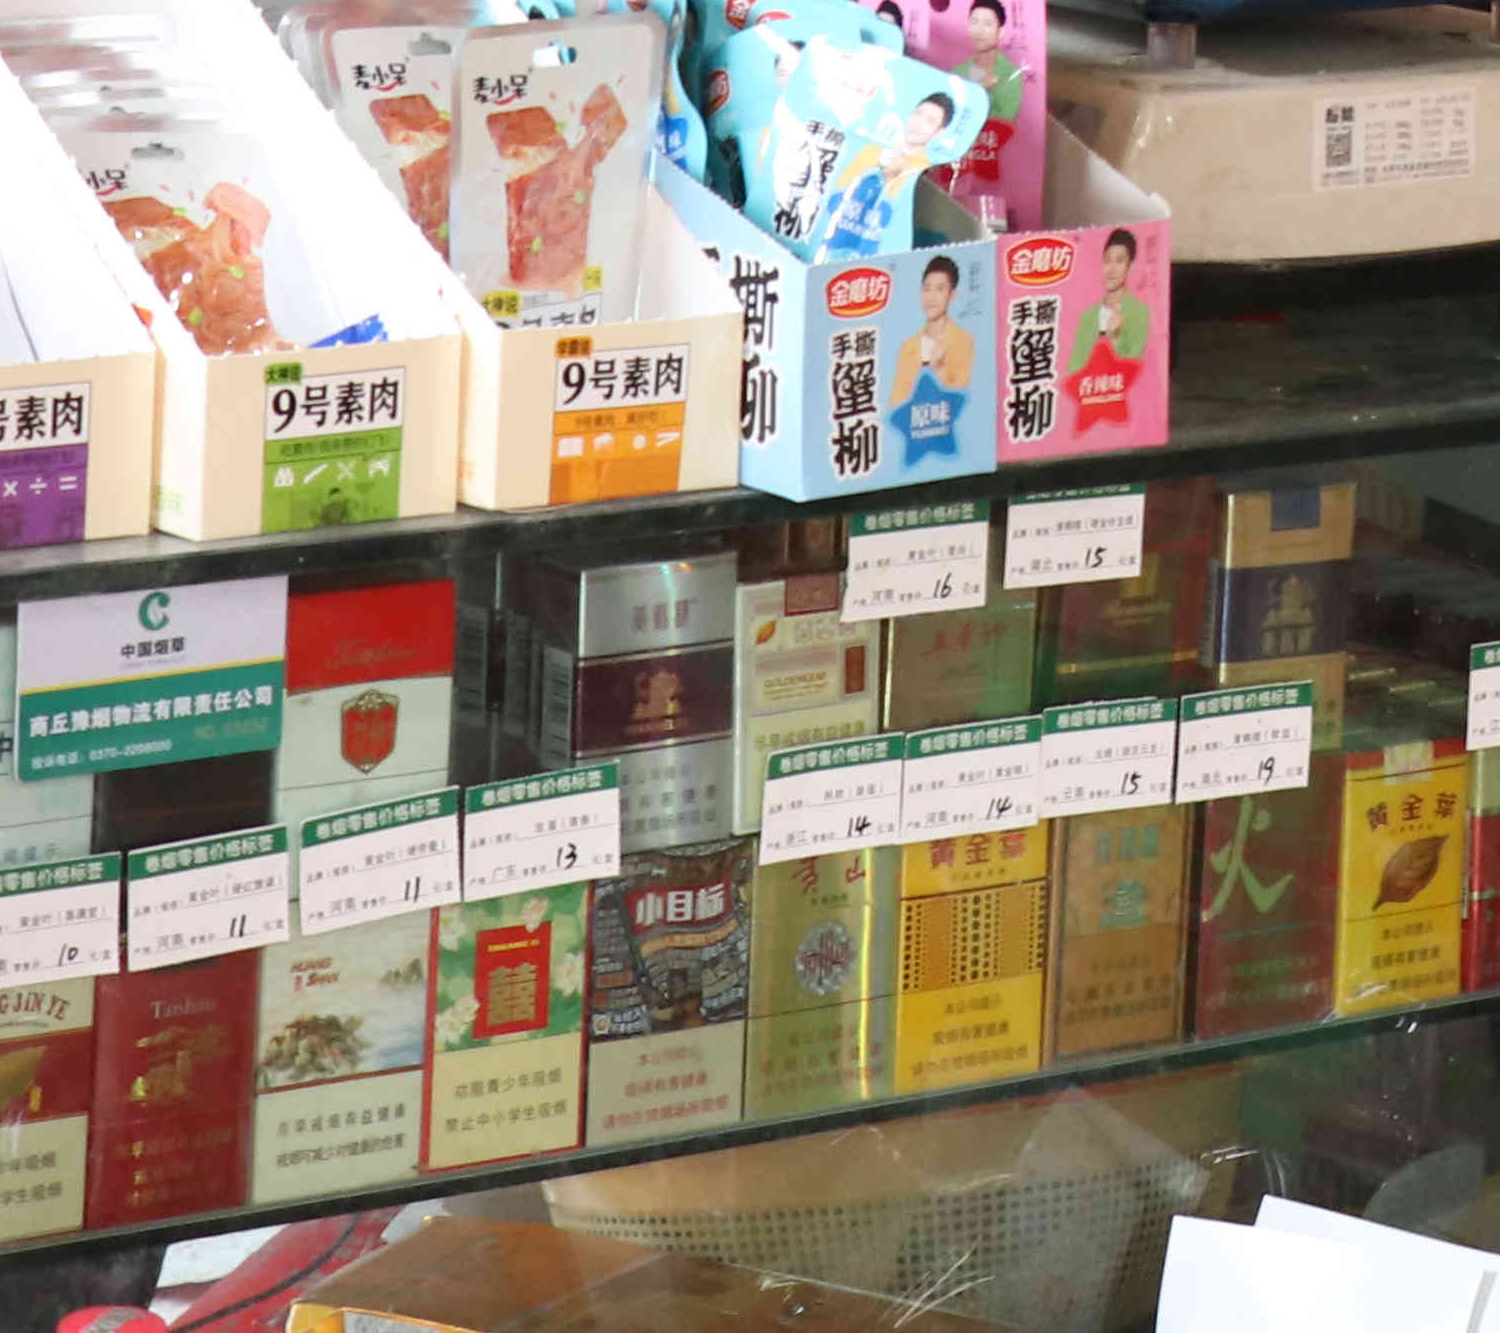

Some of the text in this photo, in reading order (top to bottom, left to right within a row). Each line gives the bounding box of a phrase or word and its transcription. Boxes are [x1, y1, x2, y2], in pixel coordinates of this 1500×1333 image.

[471, 73, 531, 105] 麦小呆
[1010, 242, 1073, 277] 金磨坊
[826, 275, 890, 308] 金磨坊
[1011, 299, 1058, 325] 手撕
[831, 333, 877, 359] 手撕
[561, 353, 686, 406] 9号素肉
[1008, 328, 1058, 441] 蟹柳
[270, 376, 400, 433] 9号素肉
[830, 357, 880, 476] 蟹柳
[119, 635, 188, 661] 中国烟草
[634, 881, 726, 928] 小目标
